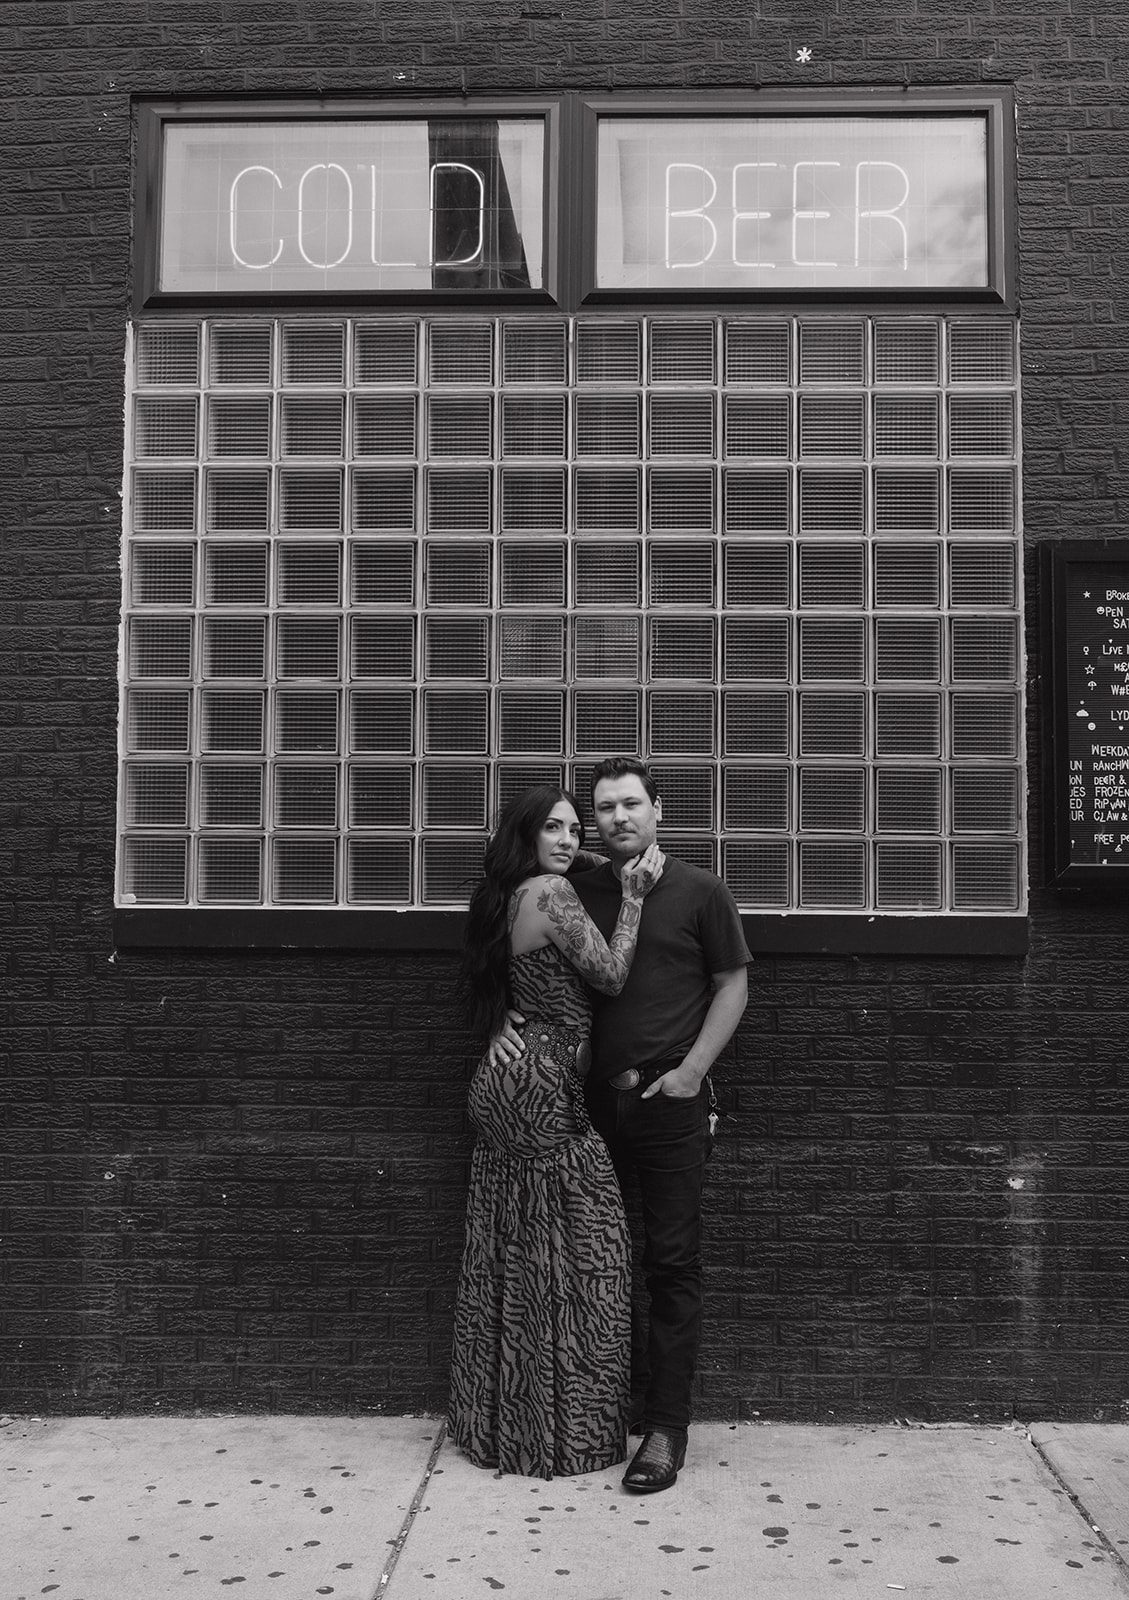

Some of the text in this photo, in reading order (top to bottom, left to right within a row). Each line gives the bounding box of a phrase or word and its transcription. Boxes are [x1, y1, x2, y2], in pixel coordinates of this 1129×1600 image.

[230, 161, 910, 270] COLD BEER
[1119, 774, 1127, 785] &
[1093, 810, 1120, 823] CLAW
[1120, 812, 1128, 821] &
[1094, 833, 1115, 845] FREE
